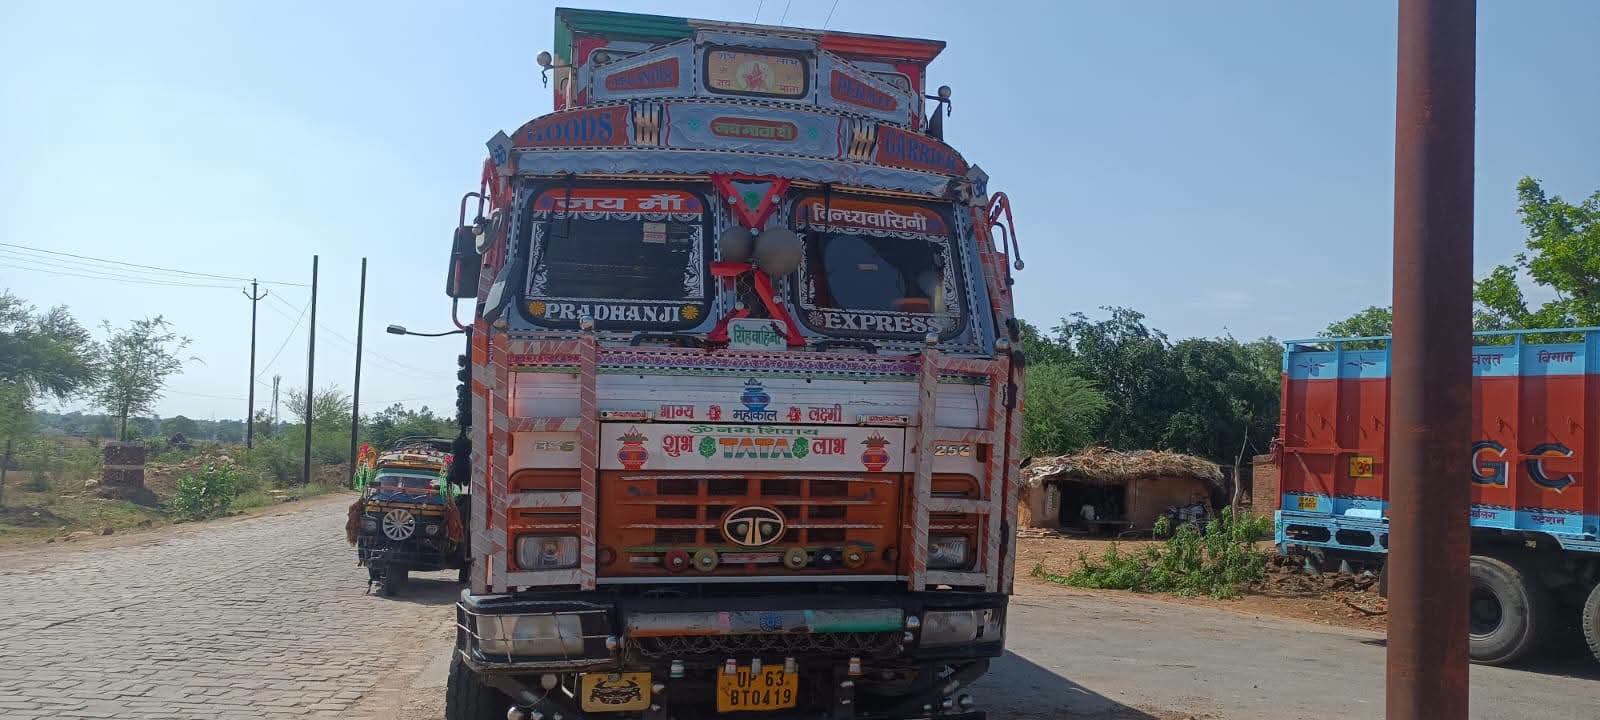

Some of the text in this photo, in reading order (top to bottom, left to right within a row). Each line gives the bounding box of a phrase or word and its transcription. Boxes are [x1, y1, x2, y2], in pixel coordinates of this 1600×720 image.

[553, 193, 686, 210] जय माँ
[811, 201, 928, 231] विन्ध्यवासिनी
[543, 302, 681, 323] PRADHANJI
[823, 312, 943, 334] EXPRESS
[660, 404, 696, 419] भाग्य
[732, 408, 778, 422] महाकाल
[808, 402, 842, 423] लक्ष्मी
[663, 435, 695, 458] शुभ
[719, 437, 793, 460] TATA
[812, 437, 847, 456] लाभ
[737, 671, 784, 688] UP 63
[730, 688, 792, 707] BT0419
